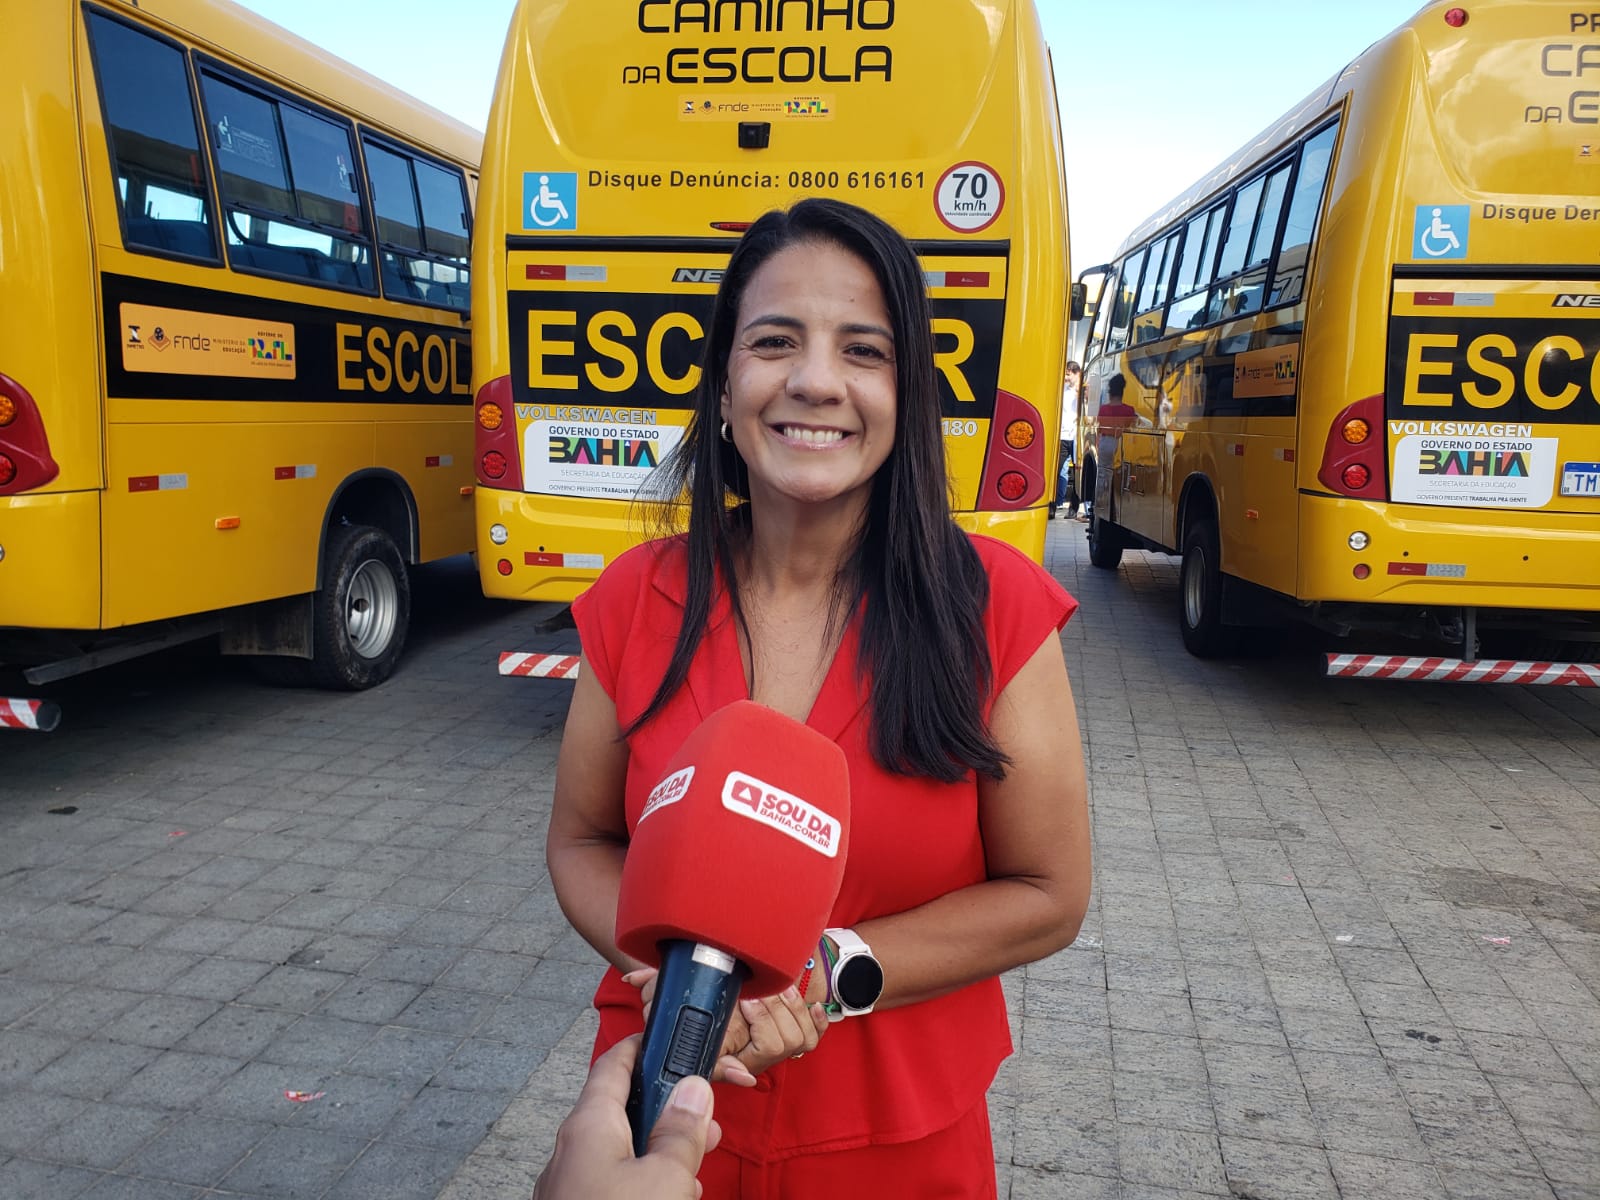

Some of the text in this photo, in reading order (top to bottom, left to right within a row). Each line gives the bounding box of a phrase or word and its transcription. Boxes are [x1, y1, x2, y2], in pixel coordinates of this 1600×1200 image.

[638, 0, 895, 33] CAMINHO
[623, 46, 892, 84] DA ESCOLA
[1525, 106, 1562, 123] DA
[588, 170, 925, 190] Disque Denúncia: 0800 616161
[952, 173, 988, 199] 70
[954, 200, 987, 211] km/h
[1483, 204, 1556, 223] Disque
[336, 322, 472, 394] ESCOL
[514, 405, 657, 425] VOLKSWAGEN
[549, 426, 660, 439] GOVERNO DO ESTADO
[1390, 421, 1533, 438] VOLKSWAGEN
[549, 436, 659, 468] BAHIA
[1421, 440, 1533, 451] GOVERNO DO ESTADO
[1419, 449, 1530, 477] BAHIA
[760, 807, 830, 848] BAHIA.COM.BR
[763, 793, 832, 841] SOU DA
